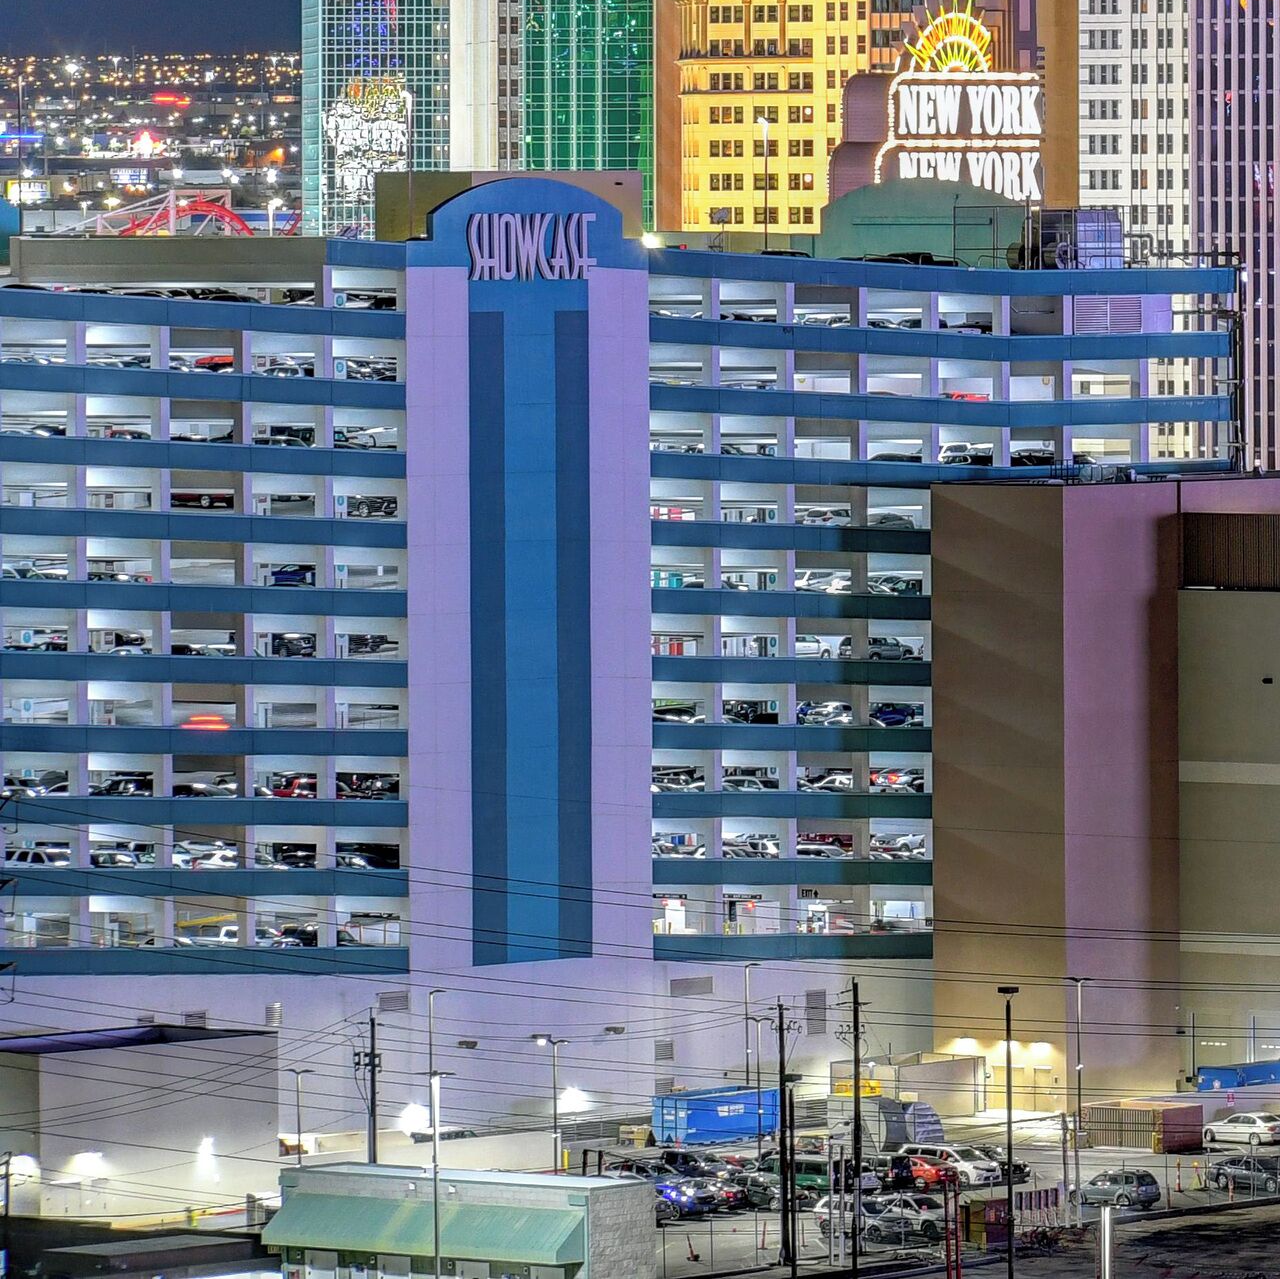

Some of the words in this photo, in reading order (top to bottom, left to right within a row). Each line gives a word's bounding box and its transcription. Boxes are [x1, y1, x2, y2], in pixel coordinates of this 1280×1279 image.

[898, 84, 962, 135] NEW
[966, 84, 1041, 136] YORK
[898, 151, 962, 182] NEW
[966, 151, 1041, 201] YORK
[467, 213, 598, 282] SHOWCASE
